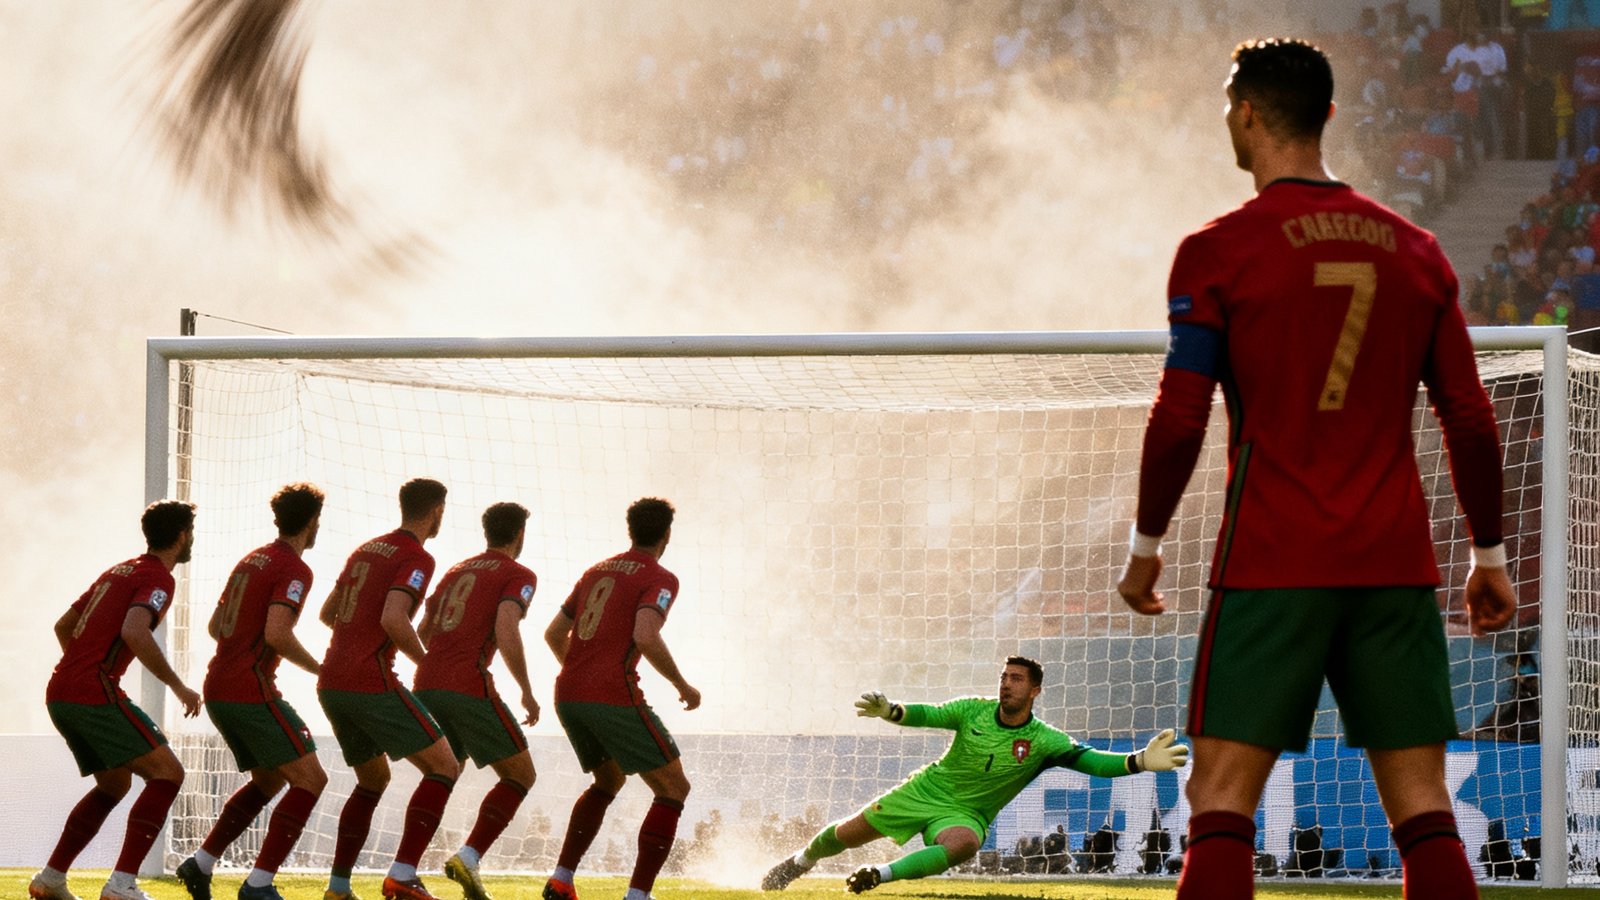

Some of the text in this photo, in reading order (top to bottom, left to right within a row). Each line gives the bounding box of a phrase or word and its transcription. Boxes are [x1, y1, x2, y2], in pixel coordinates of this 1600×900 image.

[1313, 262, 1377, 411] 7
[577, 576, 616, 641] 8
[984, 753, 994, 772] 1
